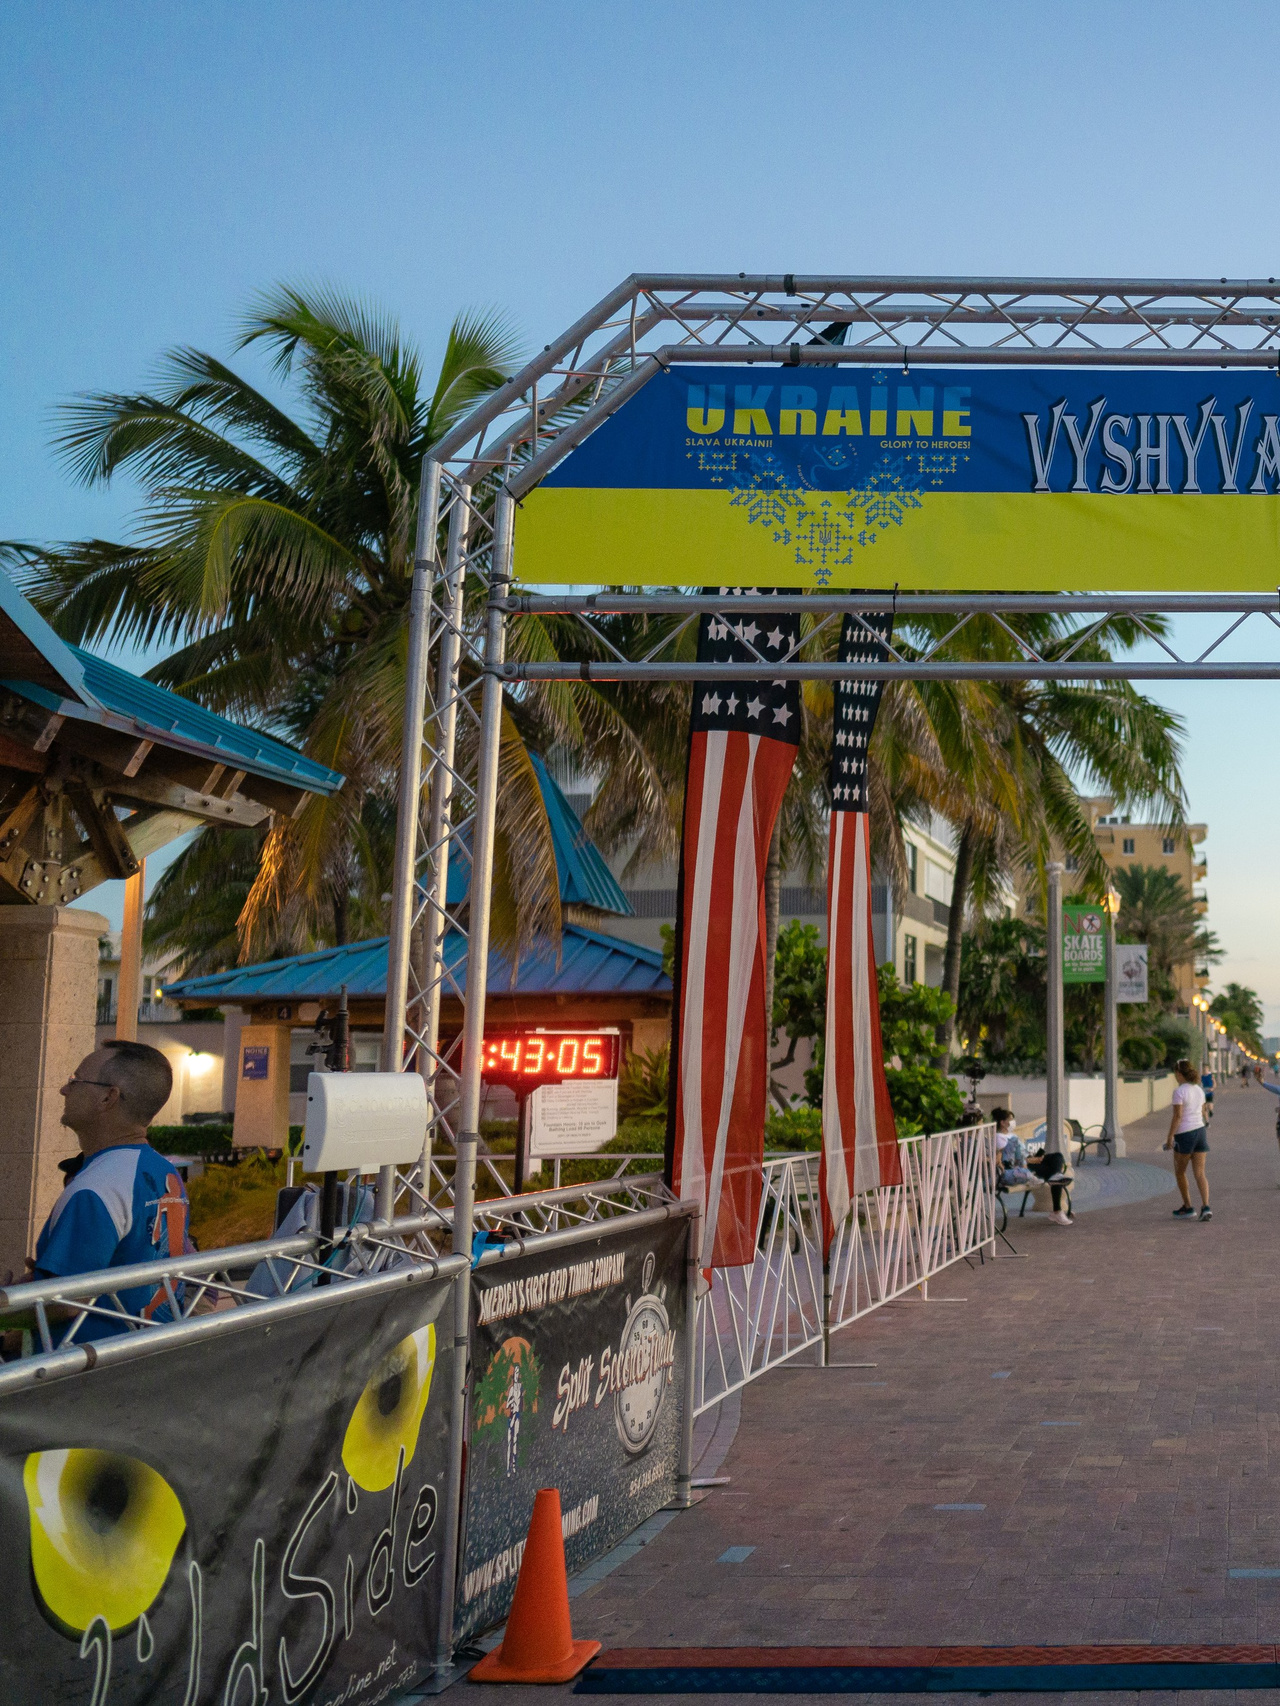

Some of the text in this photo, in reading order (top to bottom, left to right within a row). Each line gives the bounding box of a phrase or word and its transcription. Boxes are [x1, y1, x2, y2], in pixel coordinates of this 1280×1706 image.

[686, 384, 972, 437] UKRAINE
[685, 437, 774, 448] SLAVA UKRAINI!
[880, 440, 971, 450] GLORY TO HEROES!
[1064, 934, 1103, 950] SKATE
[1064, 949, 1103, 962] BOARDS
[477, 1252, 626, 1326] AMERICA'S FIRST RFID TIMING COMPANY
[552, 1355, 594, 1434] Split
